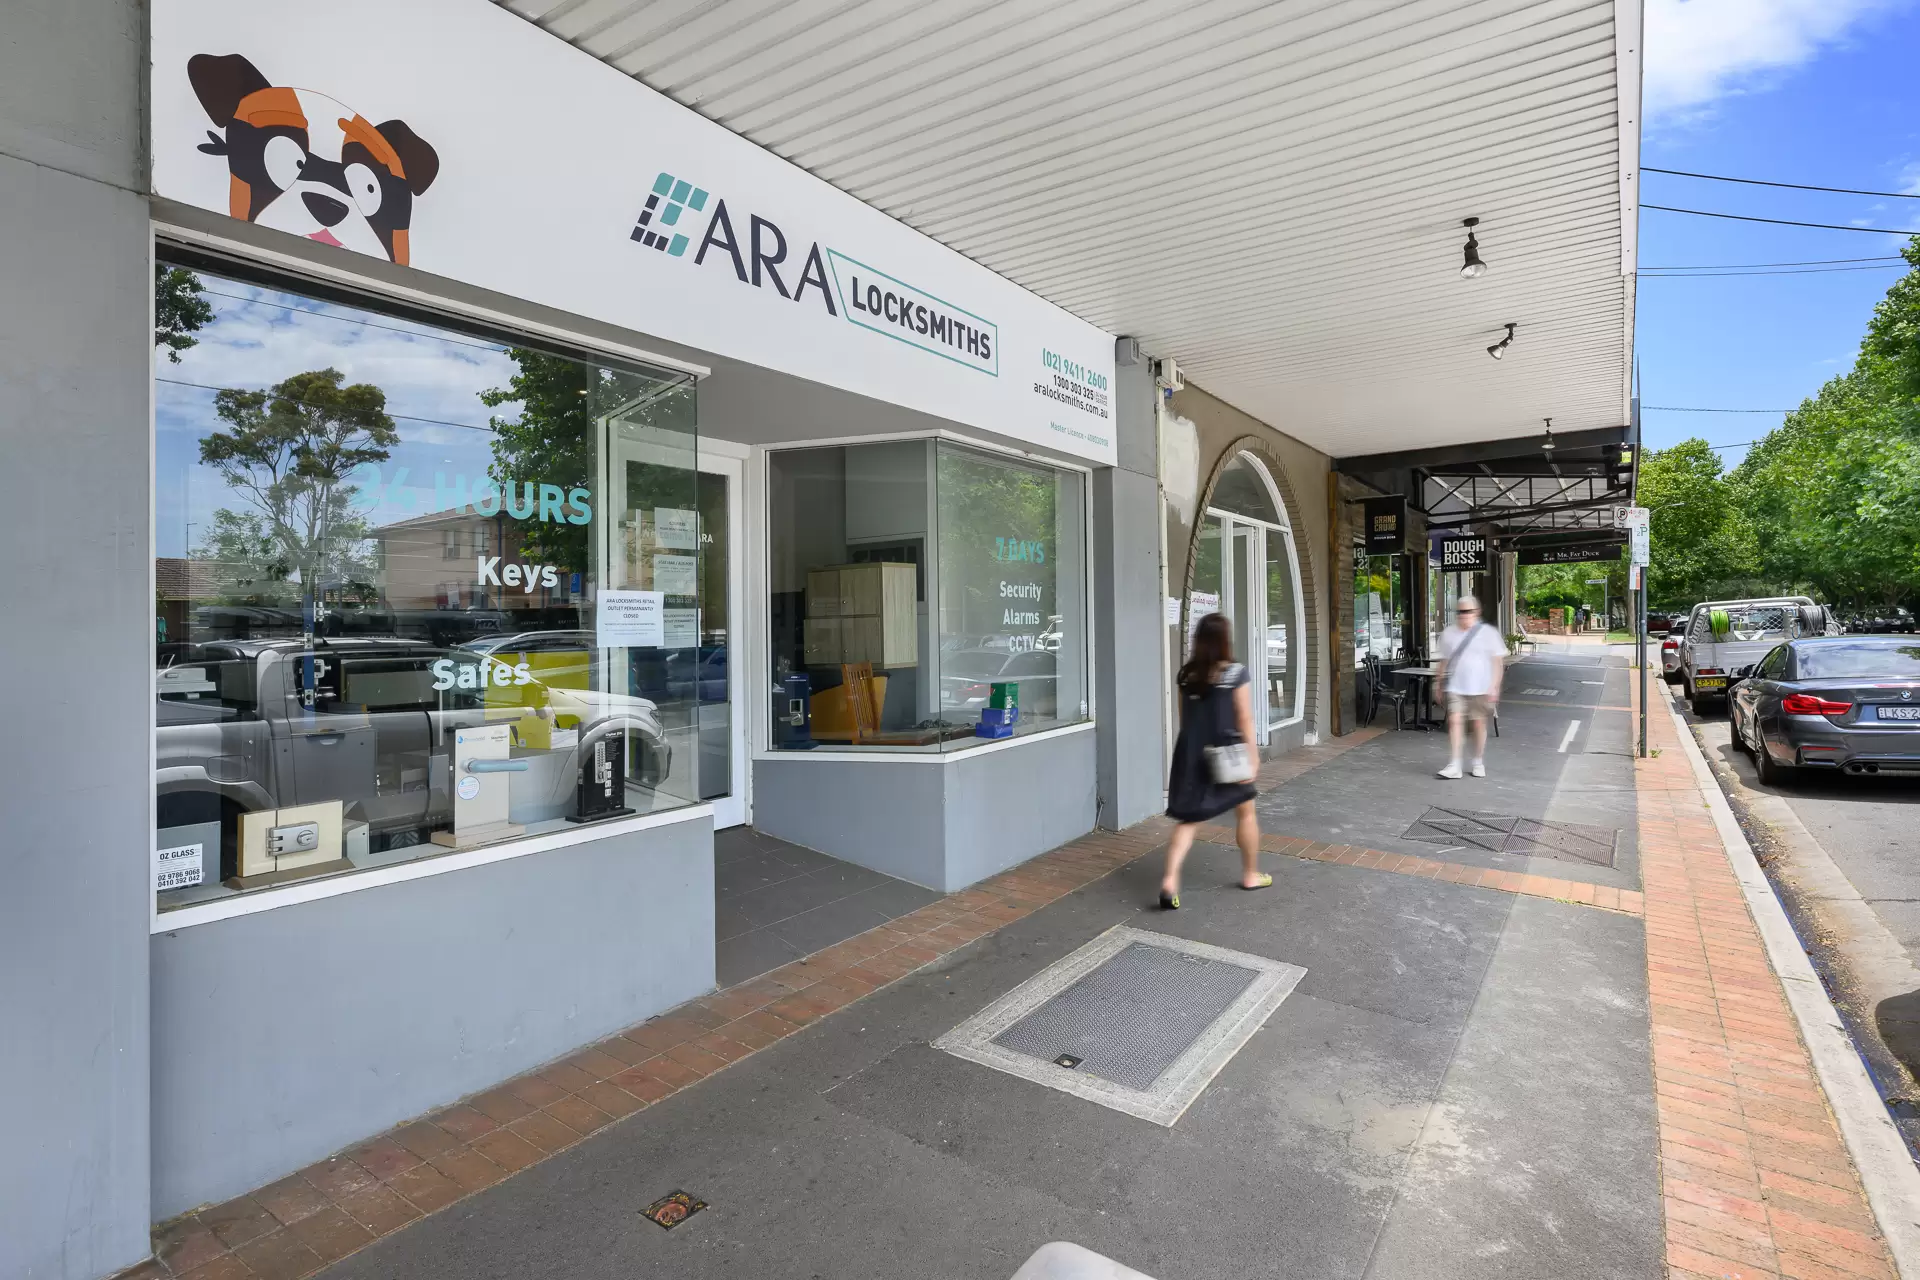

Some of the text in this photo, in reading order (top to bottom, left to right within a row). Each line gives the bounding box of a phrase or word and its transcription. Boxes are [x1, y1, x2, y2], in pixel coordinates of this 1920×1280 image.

[694, 198, 837, 317] ARA
[852, 276, 991, 360] LOCKSMITHS
[1042, 347, 1107, 392] (02) 9411 2600
[1054, 374, 1094, 400] 1300 303 325
[1033, 382, 1108, 419] aralocksmiths.com.au
[1050, 421, 1067, 433] Master
[435, 470, 593, 526] HOURS
[1374, 515, 1397, 524] GRAND
[995, 536, 1045, 564] 7 DAYS
[1443, 539, 1485, 553] DOUGH
[1443, 552, 1480, 565] BOSS.
[478, 555, 559, 593] Keys
[1000, 580, 1042, 602] Security
[1003, 608, 1040, 625] Alarms
[1008, 634, 1036, 652] CCTV
[432, 656, 531, 691] Safes
[160, 848, 195, 860] OZ GLASS
[157, 874, 166, 882] 02
[157, 879, 174, 888] 0410
[175, 877, 187, 885] 392
